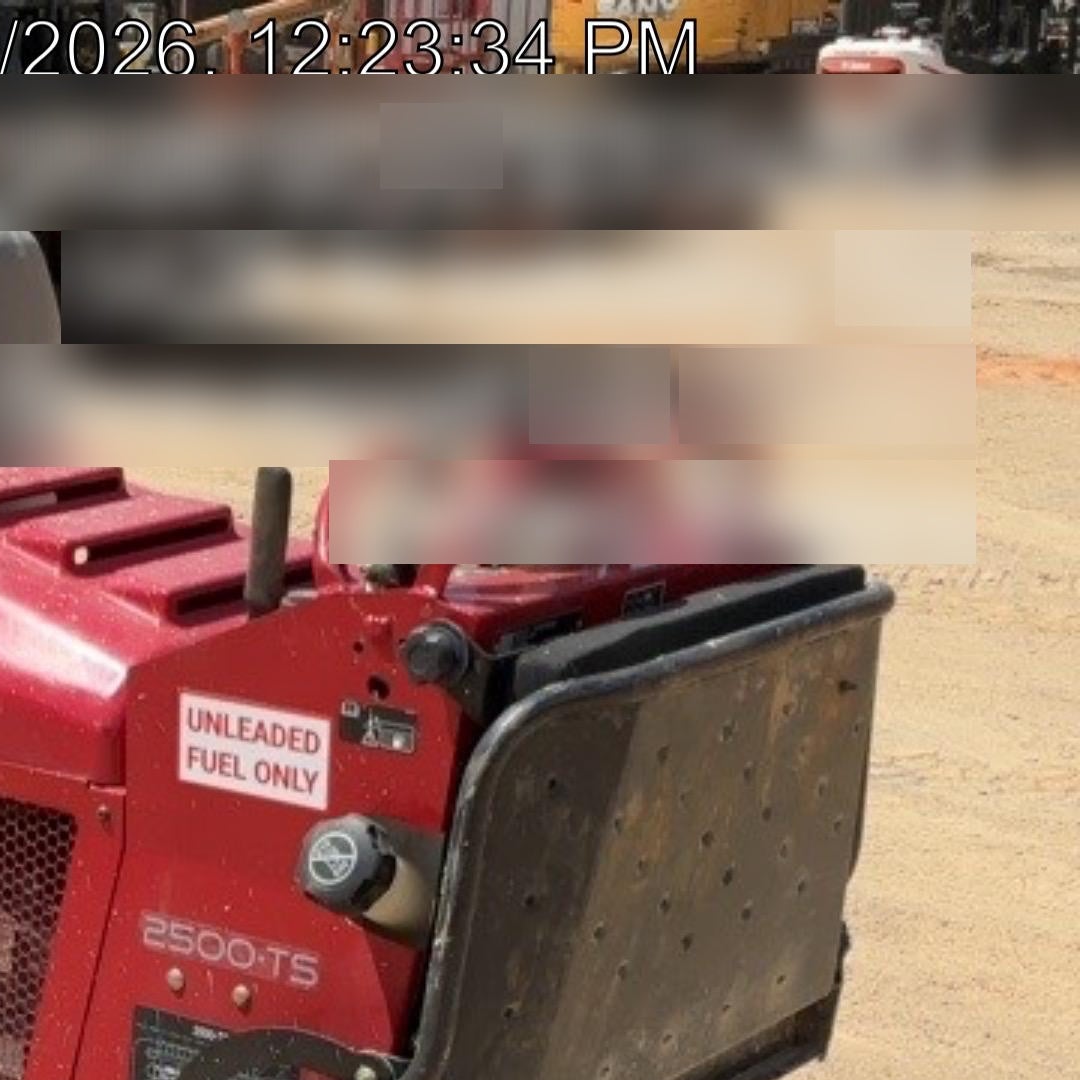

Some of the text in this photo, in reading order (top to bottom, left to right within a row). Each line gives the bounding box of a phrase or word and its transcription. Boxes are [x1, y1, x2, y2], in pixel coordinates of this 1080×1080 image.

[187, 706, 322, 755] UNLEADED
[187, 746, 320, 796] FUEL ONLY
